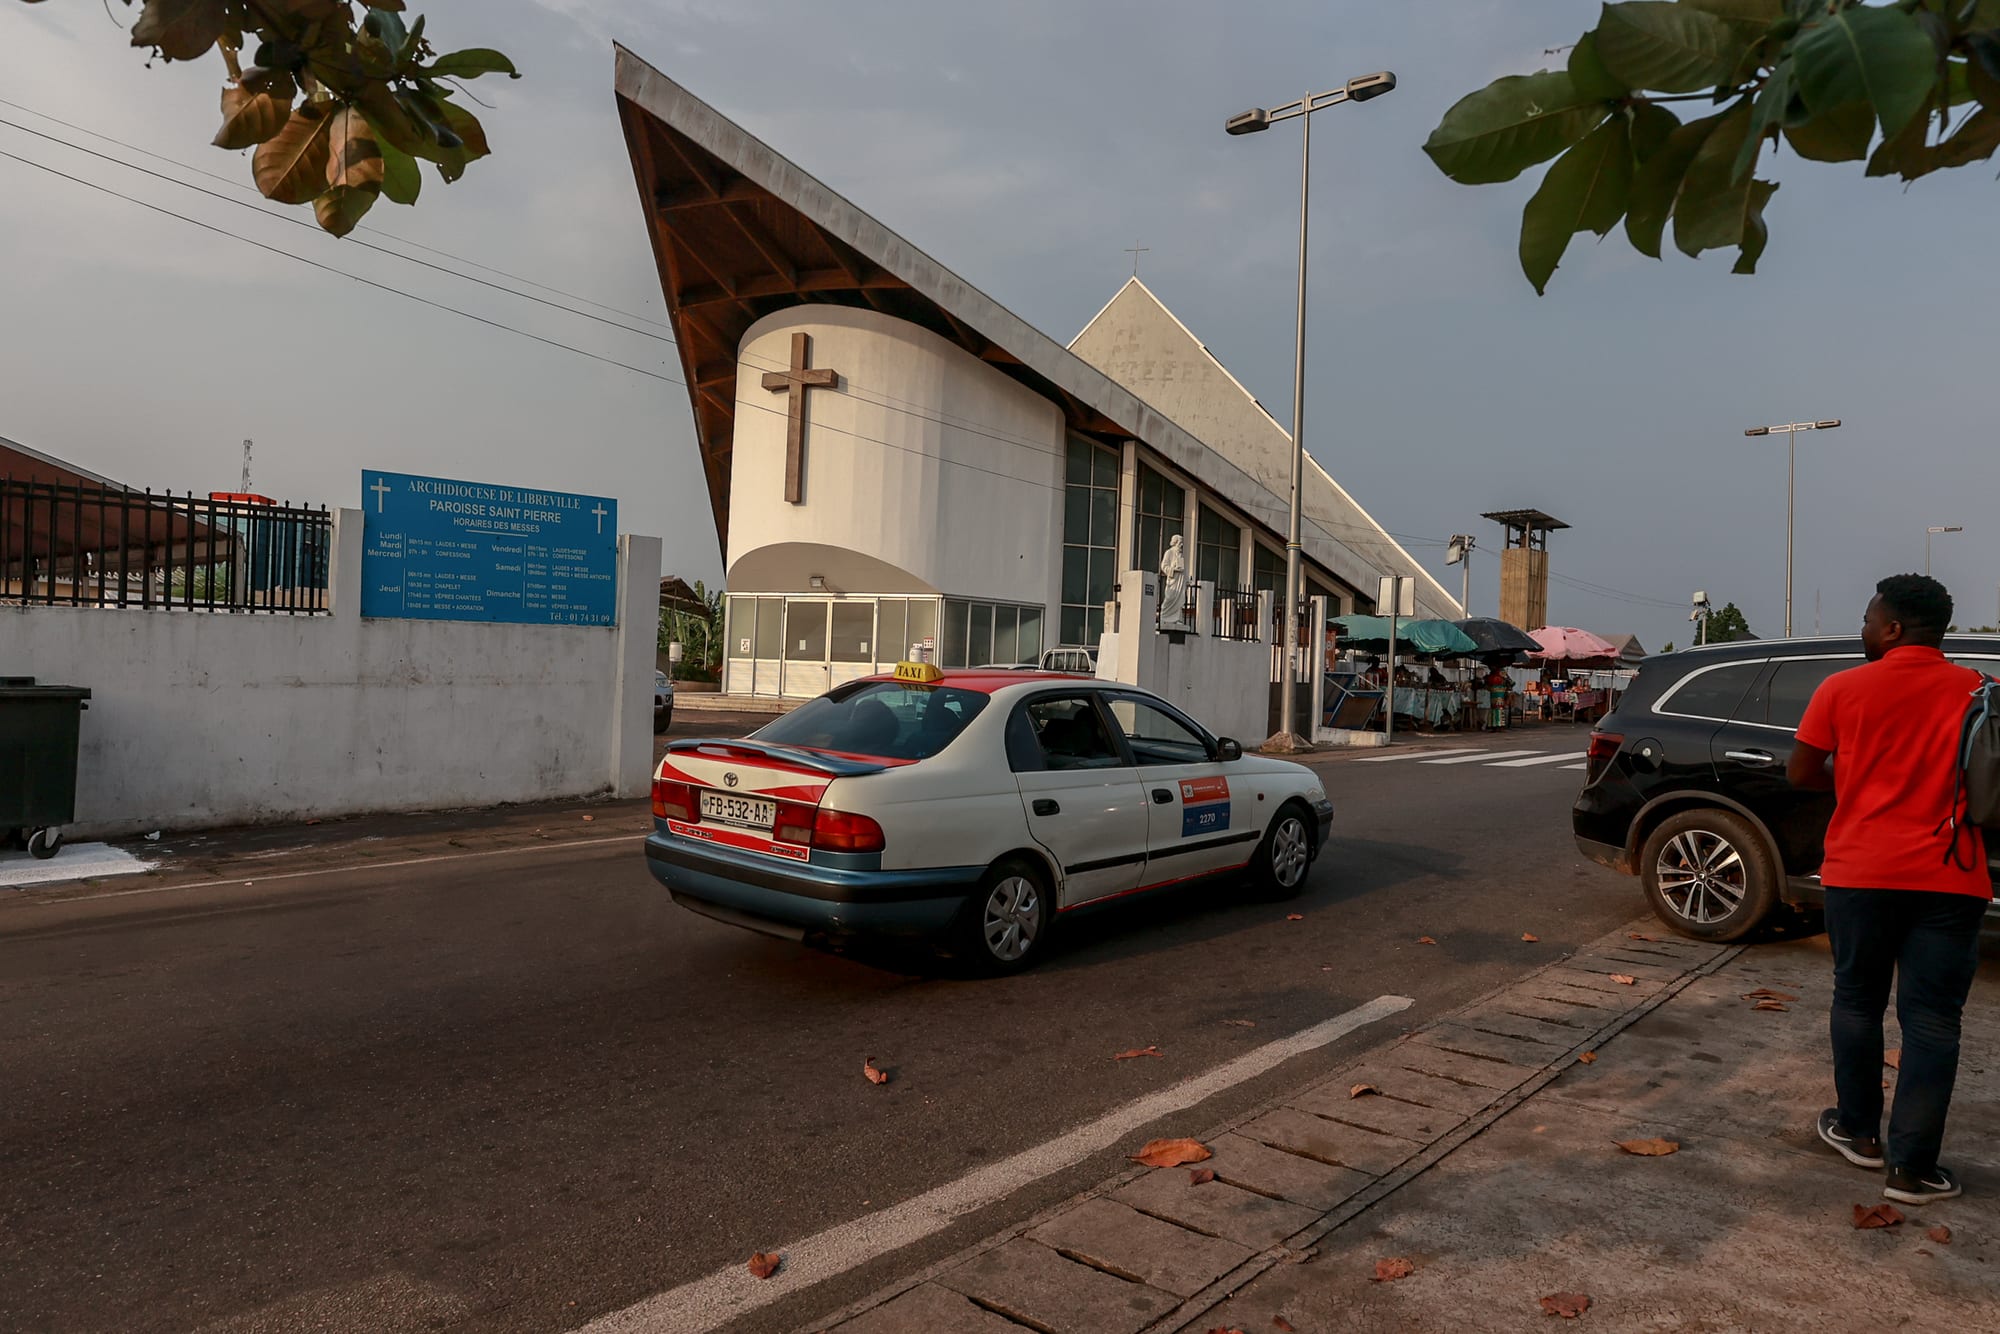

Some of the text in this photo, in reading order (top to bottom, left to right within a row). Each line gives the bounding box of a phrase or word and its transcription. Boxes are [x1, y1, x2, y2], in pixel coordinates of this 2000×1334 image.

[408, 480, 581, 510] ARCHIDIOCESE DE LIBREVILLE
[430, 499, 561, 523] PAROISSE SAINT PIERRE
[453, 517, 540, 533] HORAIRES DES MESSES
[380, 532, 402, 540] Lundi
[380, 541, 402, 549] Mardi
[460, 542, 477, 550] MESSE
[491, 545, 522, 554] Vendredi
[367, 549, 402, 558] Mercredi
[495, 563, 521, 572] Samedi
[379, 584, 401, 593] Jeudi
[486, 590, 521, 598] Dimanche
[569, 613, 578, 621] 01
[581, 613, 589, 622] 74
[591, 614, 599, 622] 31
[601, 614, 610, 623] 09
[898, 665, 921, 679] TAXI
[708, 796, 768, 823] FB-532-AA
[1199, 812, 1216, 824] 2270
